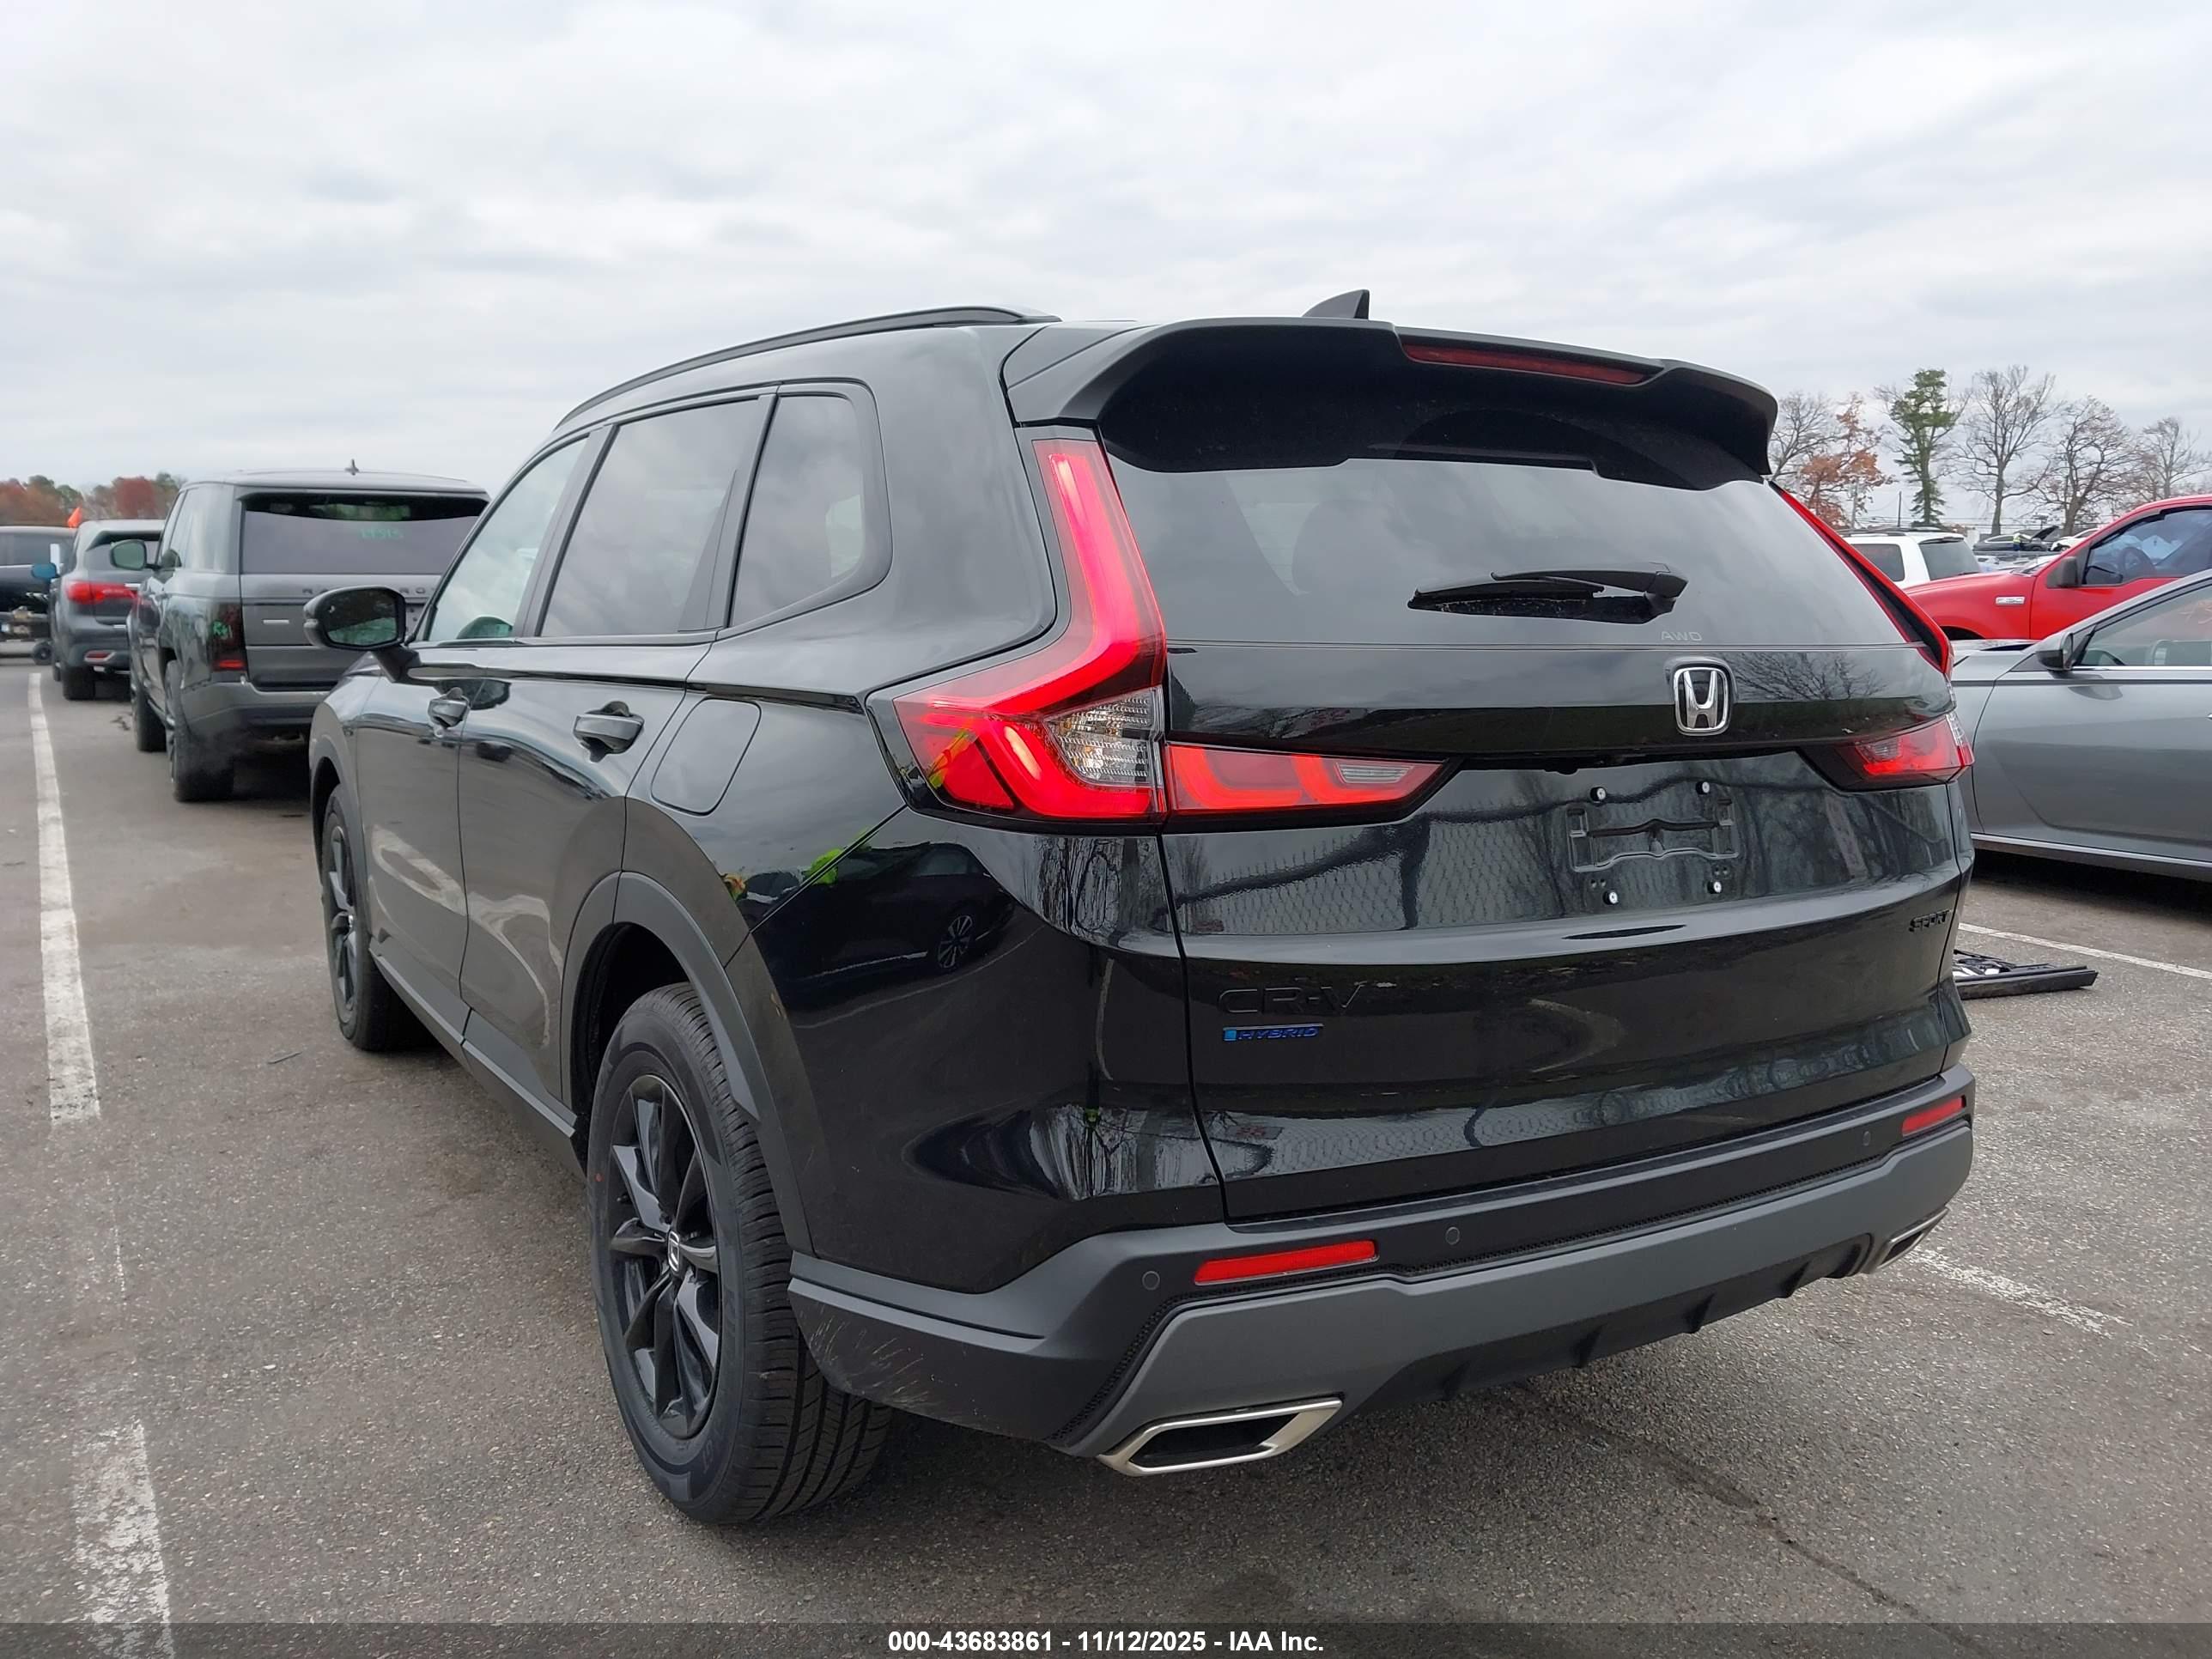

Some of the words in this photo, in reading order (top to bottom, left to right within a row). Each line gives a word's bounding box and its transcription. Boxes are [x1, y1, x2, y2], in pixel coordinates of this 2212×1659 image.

[1662, 631, 1702, 641] AWD
[1218, 981, 1367, 1014] CR-V
[1237, 1027, 1319, 1041] HYBRID
